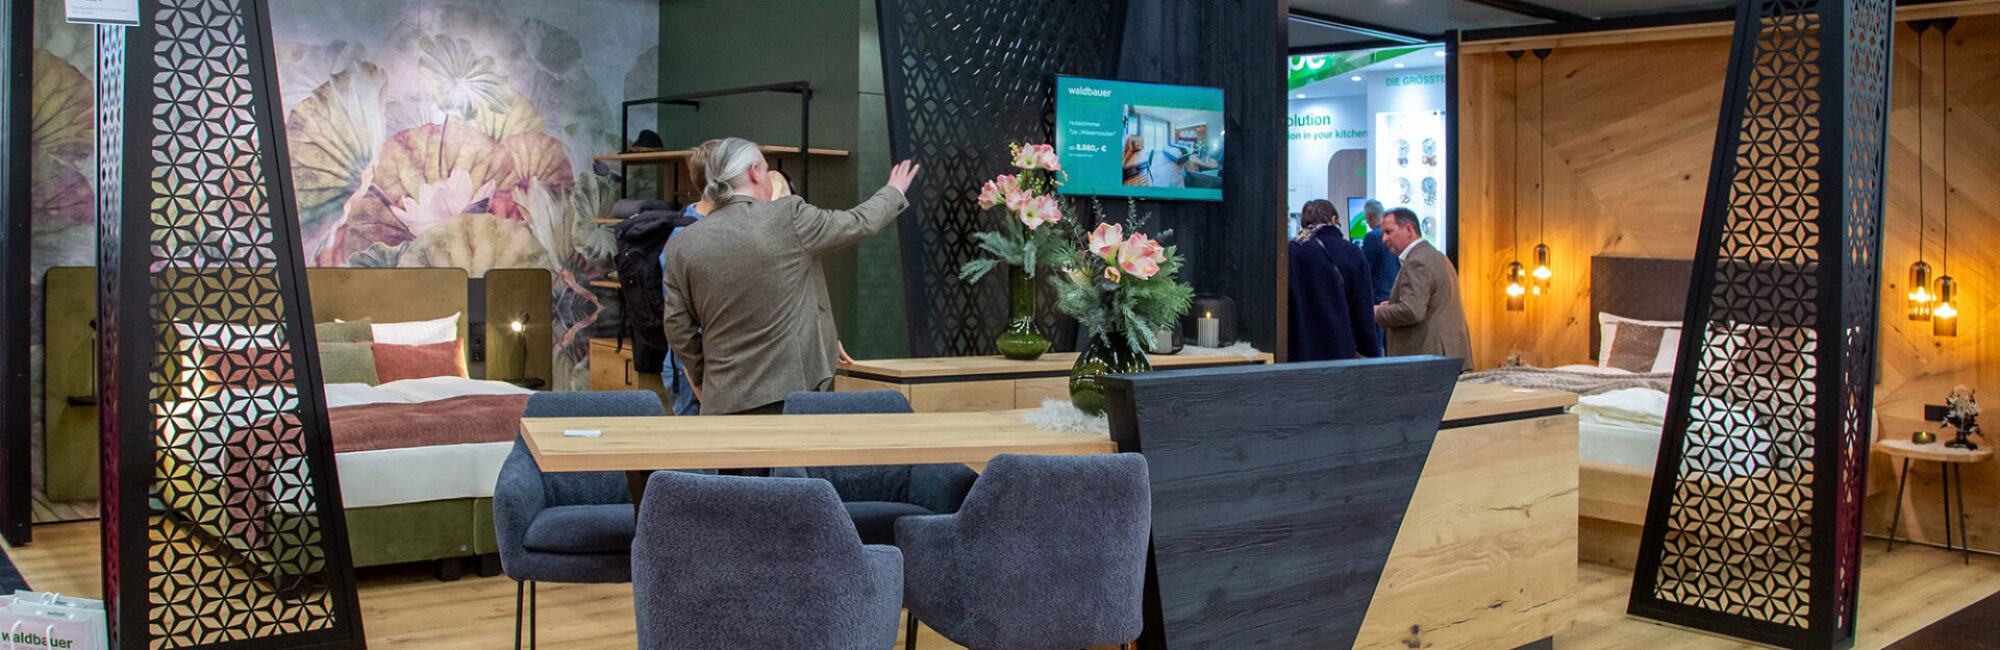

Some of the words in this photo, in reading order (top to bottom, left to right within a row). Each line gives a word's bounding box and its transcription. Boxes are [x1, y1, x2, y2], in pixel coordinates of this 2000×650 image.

[1385, 77, 1400, 87] DIE
[1068, 86, 1112, 97] waldbauer
[1303, 131, 1311, 139] in
[1313, 131, 1333, 141] your
[1101, 144, 1107, 152] €
